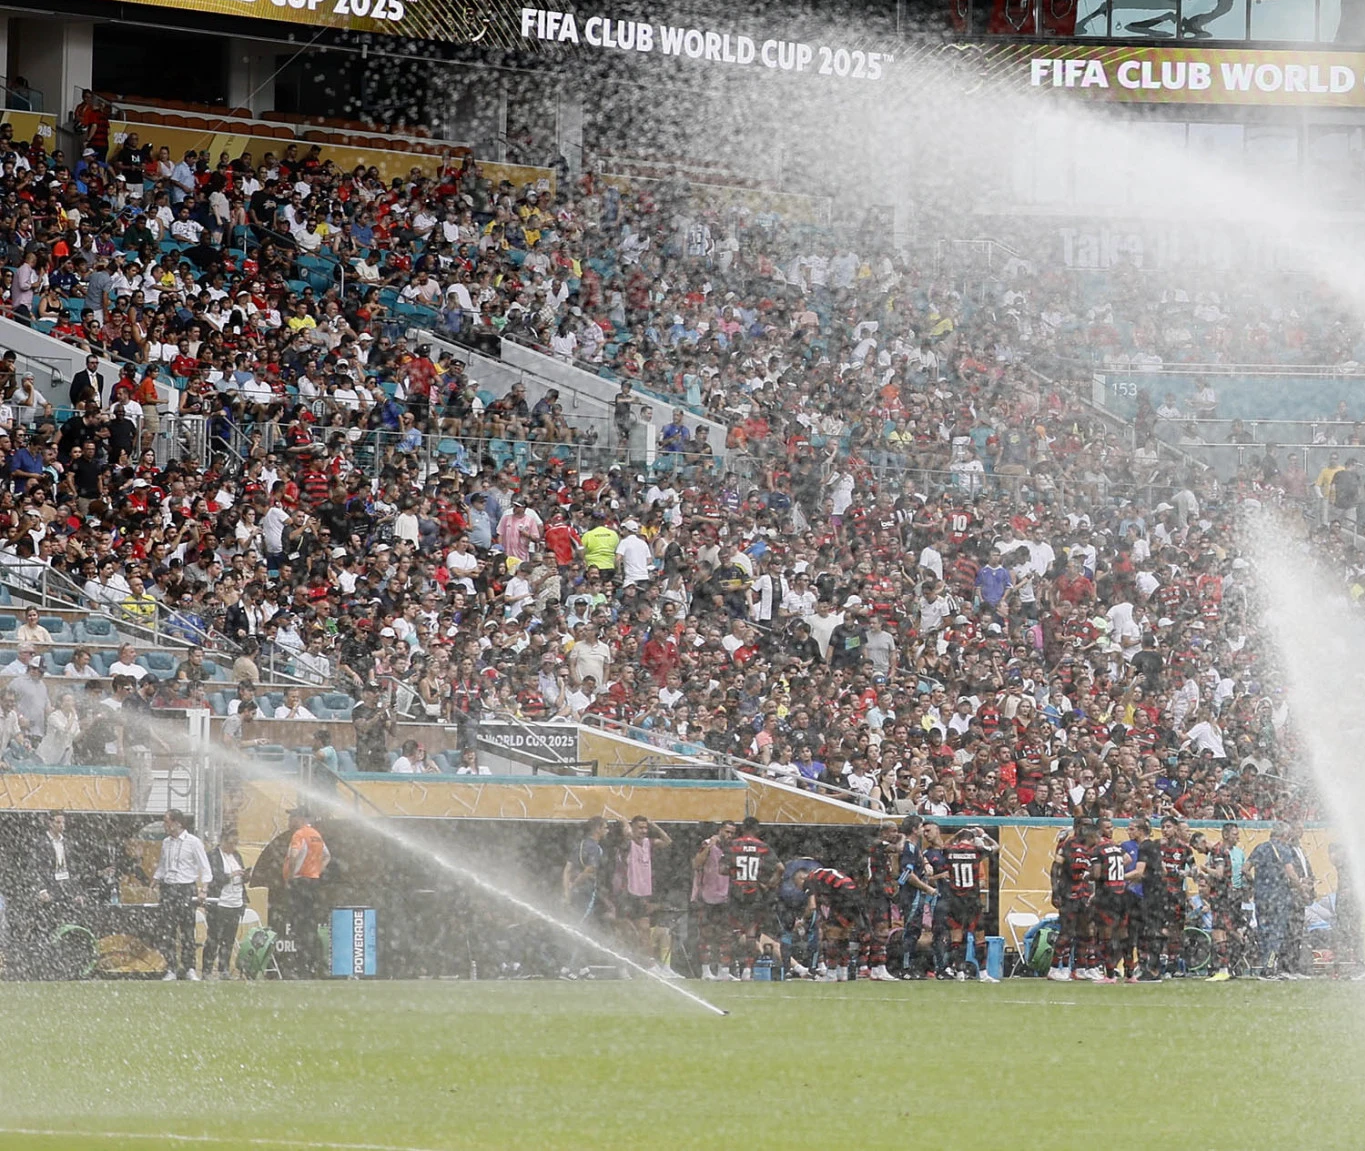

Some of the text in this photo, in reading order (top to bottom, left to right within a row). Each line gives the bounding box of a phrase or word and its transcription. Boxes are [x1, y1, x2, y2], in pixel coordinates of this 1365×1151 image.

[521, 7, 578, 44] FIFA
[585, 15, 653, 52] CLUB
[660, 26, 755, 63] WORLD
[761, 38, 811, 71] CUP
[1025, 59, 1108, 96] FIFA
[1118, 61, 1212, 90] CLUB
[1221, 64, 1355, 93] WORLD
[1112, 384, 1137, 396] 153
[952, 514, 968, 532] 10
[526, 734, 546, 746] CUP
[735, 856, 760, 881] 50
[952, 863, 974, 887] 10
[1108, 857, 1124, 881] 26
[354, 911, 364, 973] POWERADE
